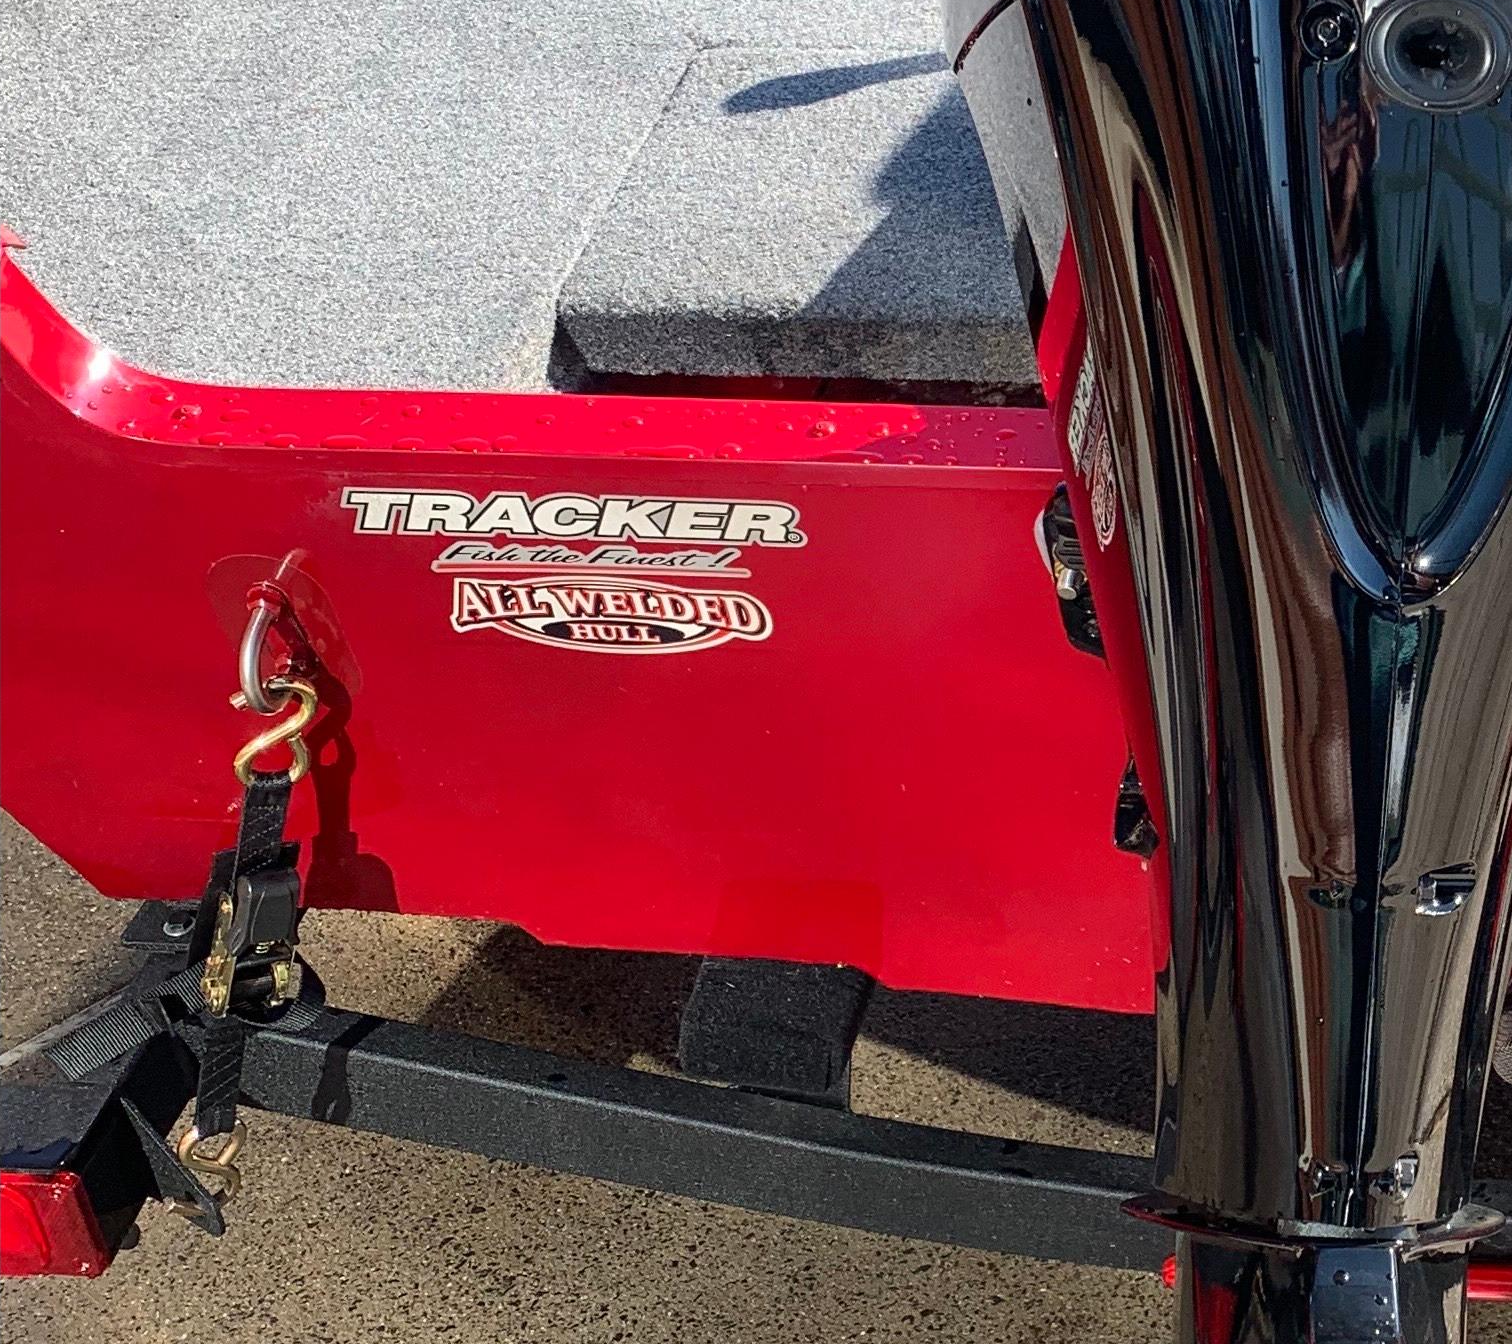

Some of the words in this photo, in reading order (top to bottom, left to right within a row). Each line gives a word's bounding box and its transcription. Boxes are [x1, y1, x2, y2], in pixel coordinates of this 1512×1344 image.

[346, 492, 792, 543] TRACKER
[445, 545, 519, 563] Fish
[529, 547, 580, 564] the
[457, 582, 545, 626] ALL
[552, 586, 763, 634] WELDED
[569, 624, 661, 642] HULL
